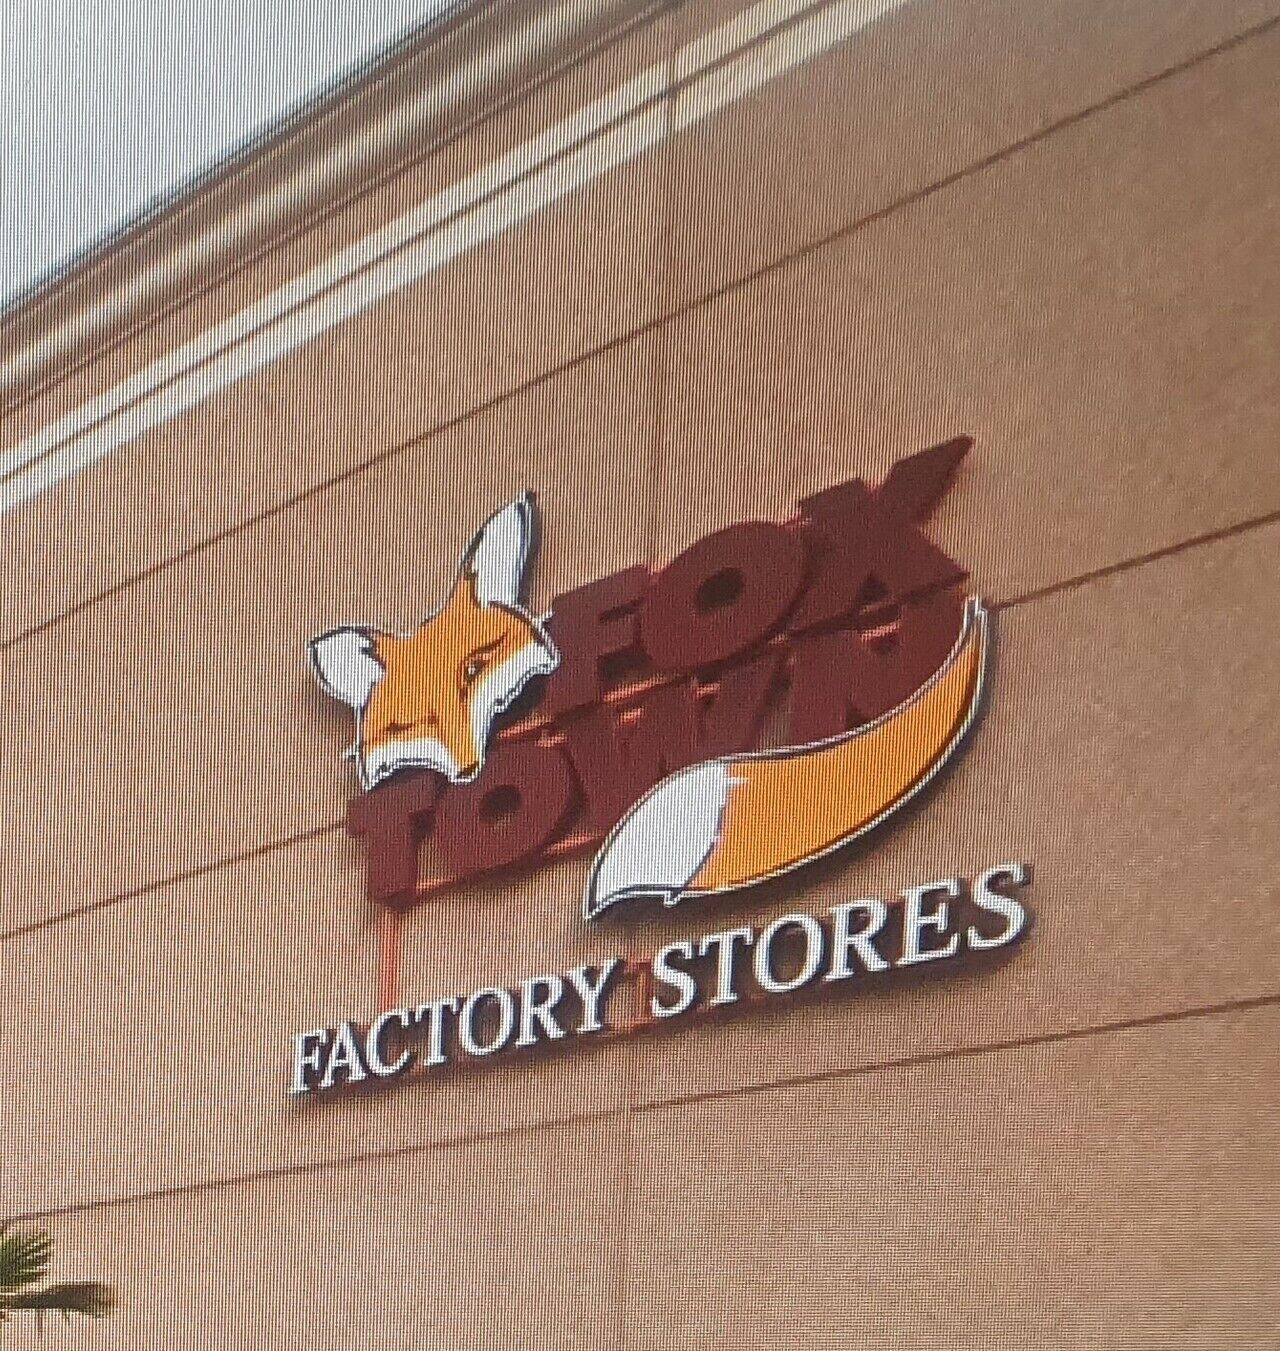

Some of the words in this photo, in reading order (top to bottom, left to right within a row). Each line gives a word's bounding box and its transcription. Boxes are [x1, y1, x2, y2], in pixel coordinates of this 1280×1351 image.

[544, 434, 974, 717] FOX
[346, 594, 968, 906] TOWN
[287, 957, 624, 1095] FACTORY
[649, 862, 1034, 1020] STORES
